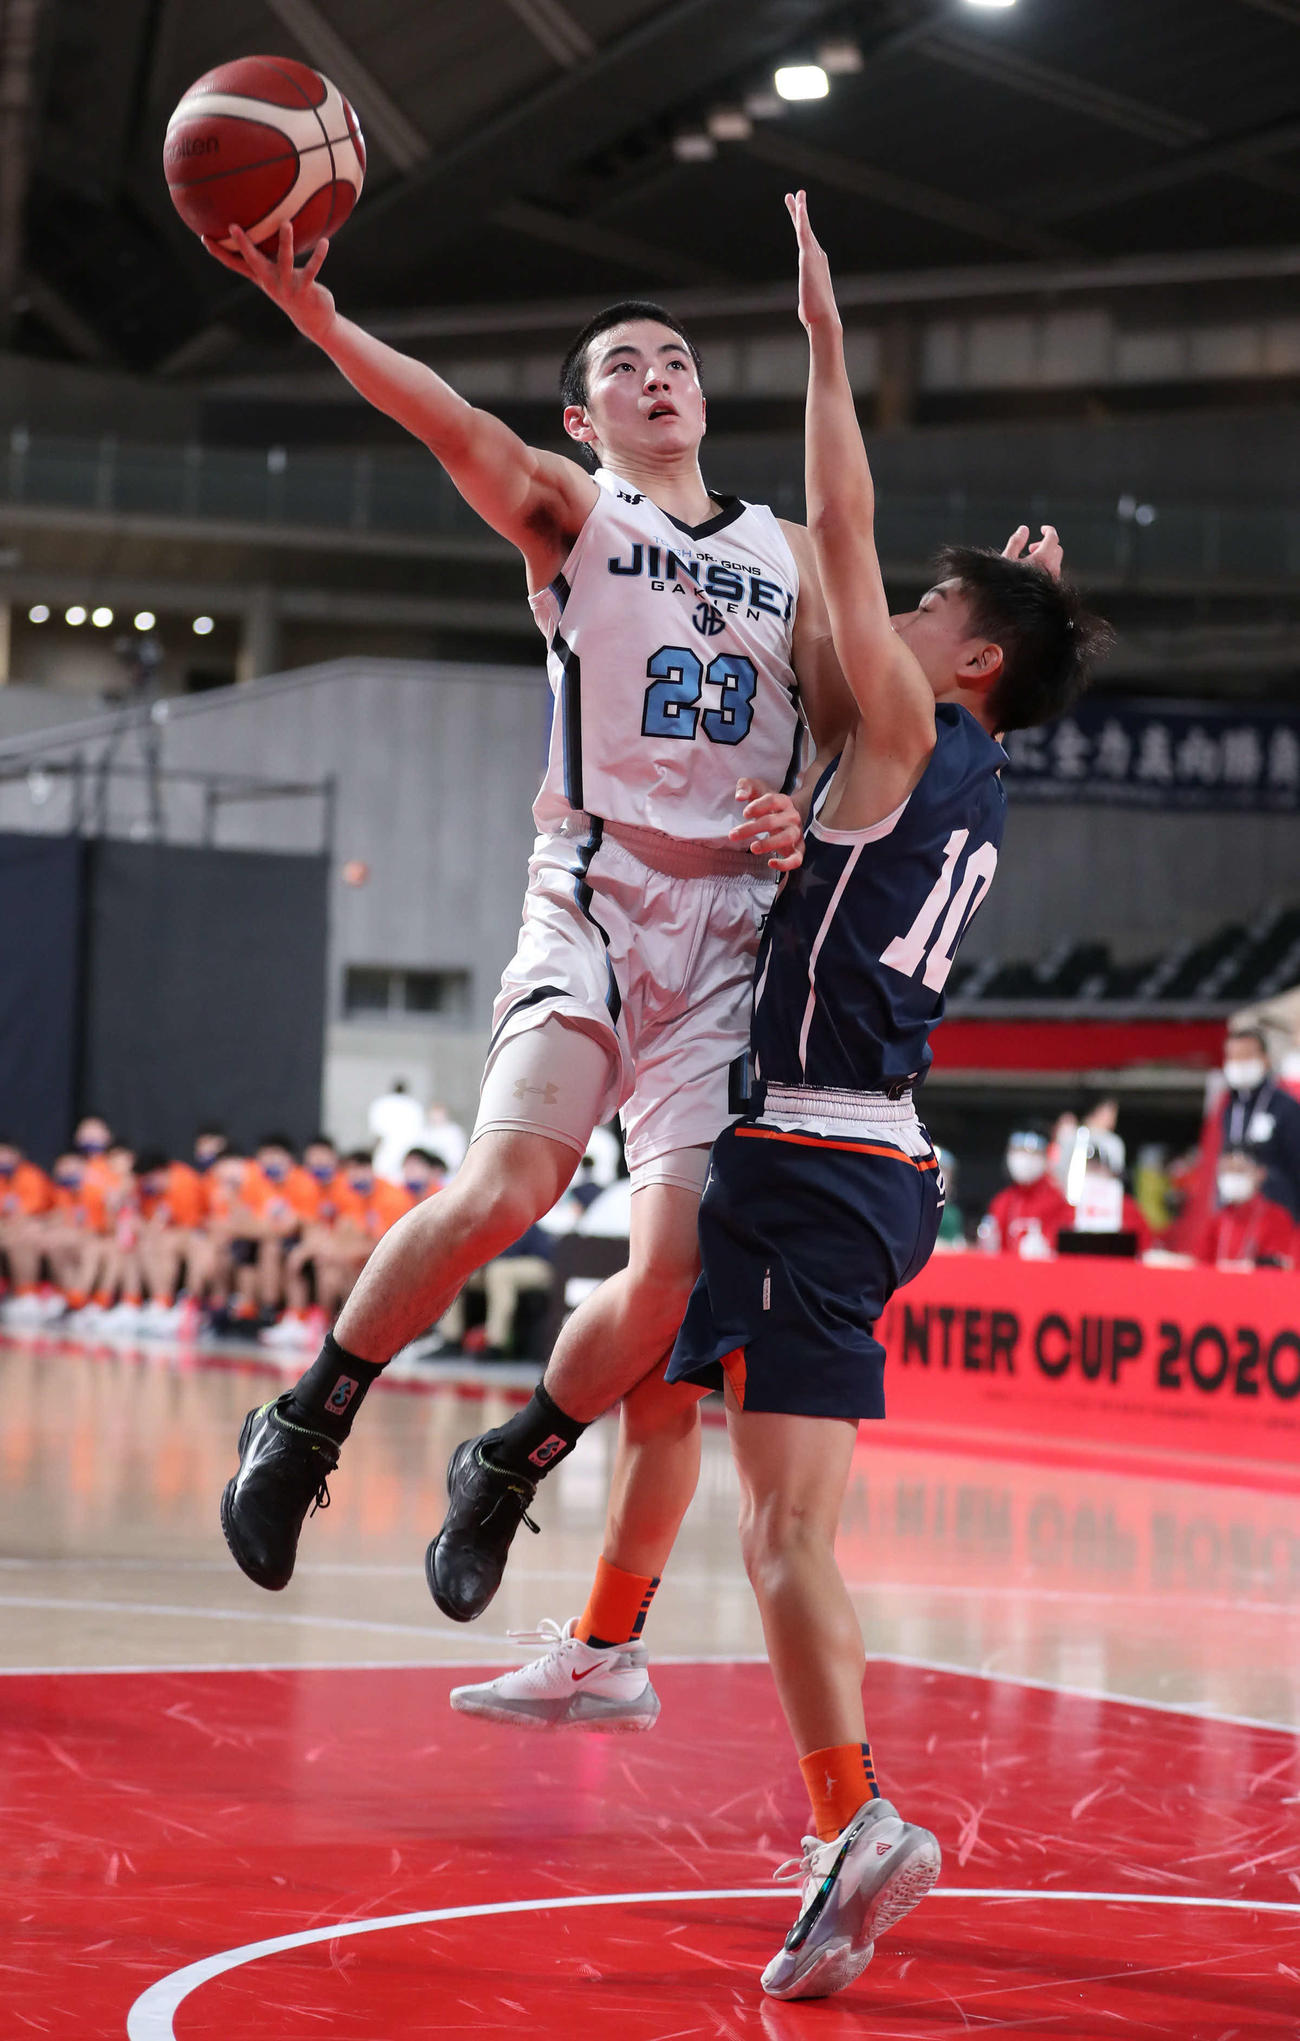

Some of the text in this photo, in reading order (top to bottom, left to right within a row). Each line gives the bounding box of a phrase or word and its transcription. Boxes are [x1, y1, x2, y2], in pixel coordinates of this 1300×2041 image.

[651, 580, 760, 622] GAKEN
[641, 645, 758, 746] 23
[878, 828, 998, 994] 10
[1033, 1312, 1143, 1385] CUP
[1156, 1318, 1300, 1400] 2020
